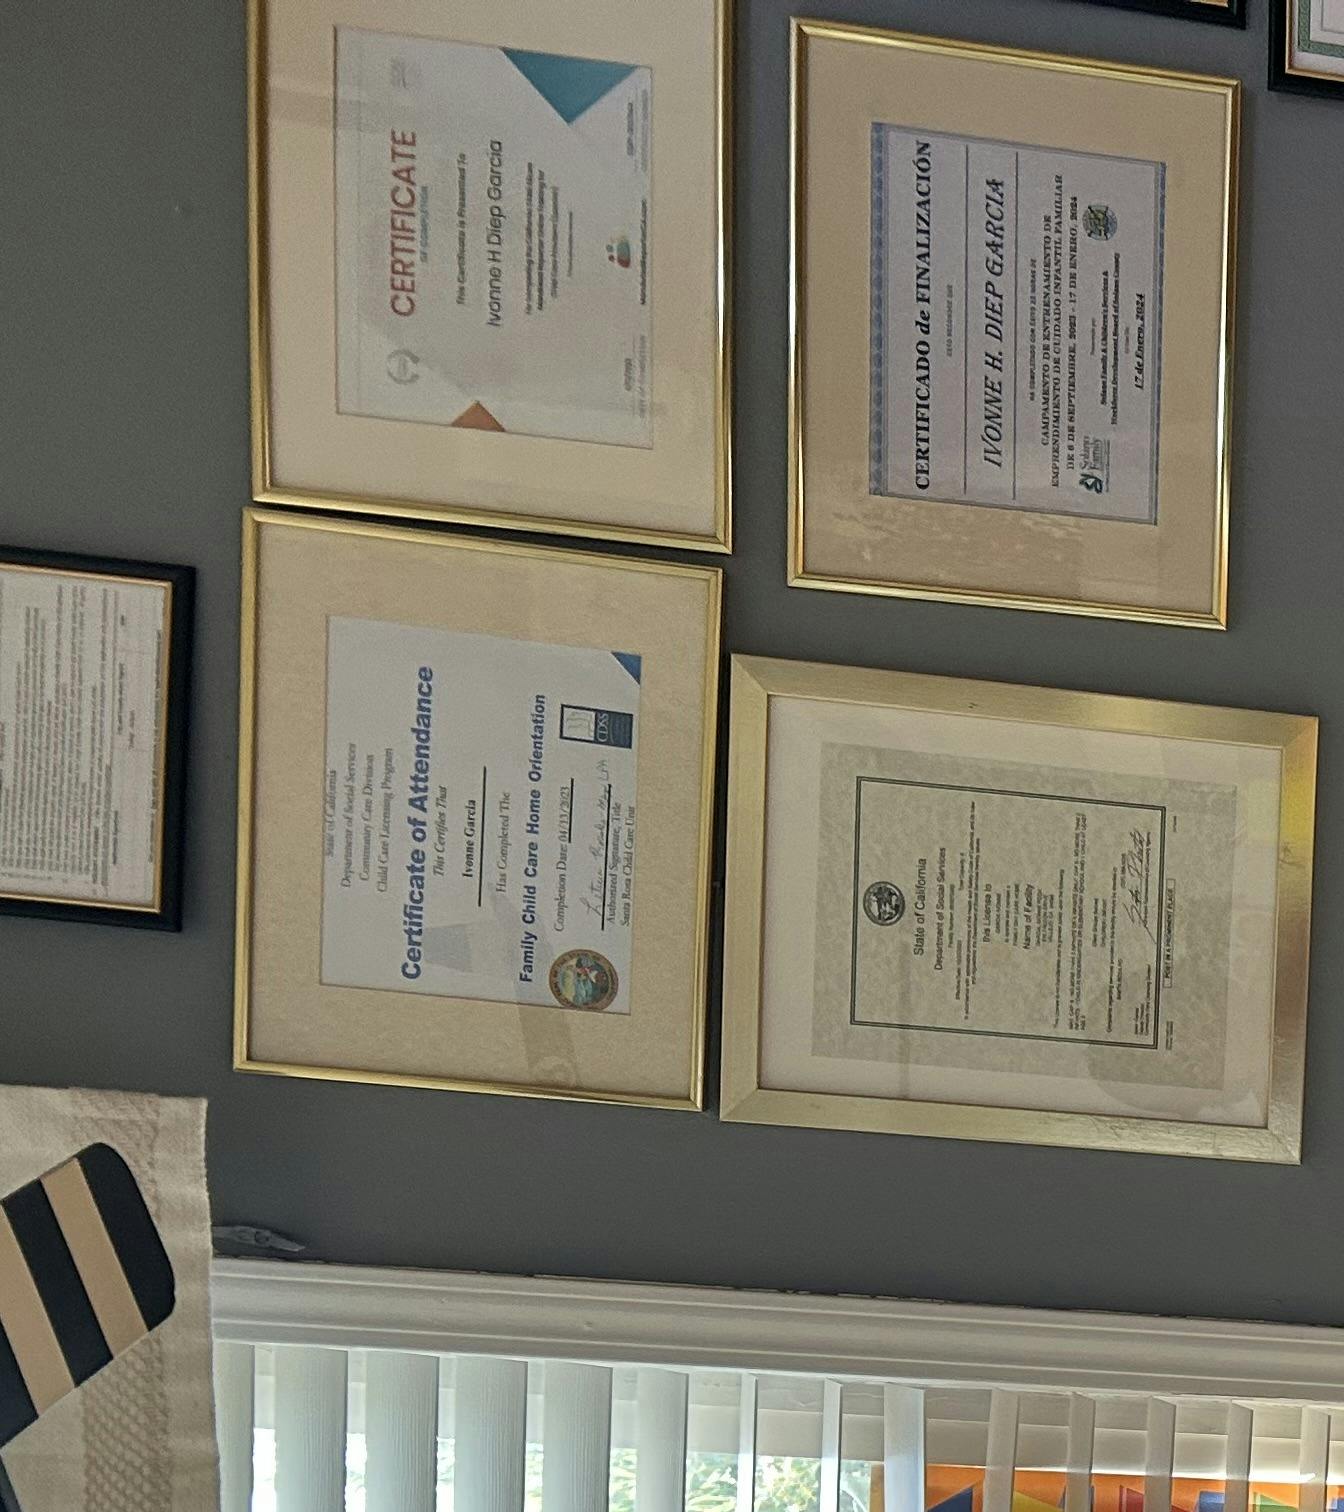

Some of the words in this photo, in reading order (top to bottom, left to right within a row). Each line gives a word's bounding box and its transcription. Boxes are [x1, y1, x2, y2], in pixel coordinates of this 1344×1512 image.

[487, 141, 503, 202] Garcia
[391, 130, 416, 317] CERTIFICATE
[487, 206, 507, 246] Diep
[912, 140, 932, 305] FINALIZACIÓN
[985, 178, 1004, 277] GARCIA
[488, 249, 503, 263] H
[1054, 238, 1062, 294] INFANTIL
[486, 266, 503, 327] Ivonne
[985, 281, 1004, 344] DIEP
[916, 309, 930, 334] de
[1053, 298, 1062, 354] CUIDADO
[984, 351, 1002, 370] H.
[1043, 344, 1050, 360] DE
[1054, 357, 1060, 373] DE
[915, 341, 931, 490] CERTIFICADO
[982, 376, 1002, 468] IVONNE
[1041, 364, 1050, 446] CAMPAMENTO
[408, 666, 432, 813] Attendance
[528, 694, 546, 782] Orientation
[437, 786, 448, 809] That
[499, 792, 510, 813] The
[526, 790, 540, 834] Home
[407, 816, 427, 842] of
[434, 812, 449, 853] Certifies
[464, 800, 476, 837] Garcia
[462, 840, 475, 878] Ivonne
[497, 815, 512, 870] Completed
[524, 842, 539, 877] Care
[433, 856, 444, 876] This
[496, 873, 508, 893] Has
[915, 858, 928, 910] California
[937, 848, 947, 883] Services
[401, 849, 426, 979] Certificate
[522, 886, 537, 924] Child
[936, 885, 946, 910] Social
[936, 912, 944, 920] of
[1025, 884, 1035, 912] Facility
[915, 913, 925, 924] of
[1023, 925, 1033, 949] Name
[1024, 914, 1033, 923] of
[520, 931, 537, 983] Family
[914, 927, 925, 956] State
[935, 922, 946, 970] Department
